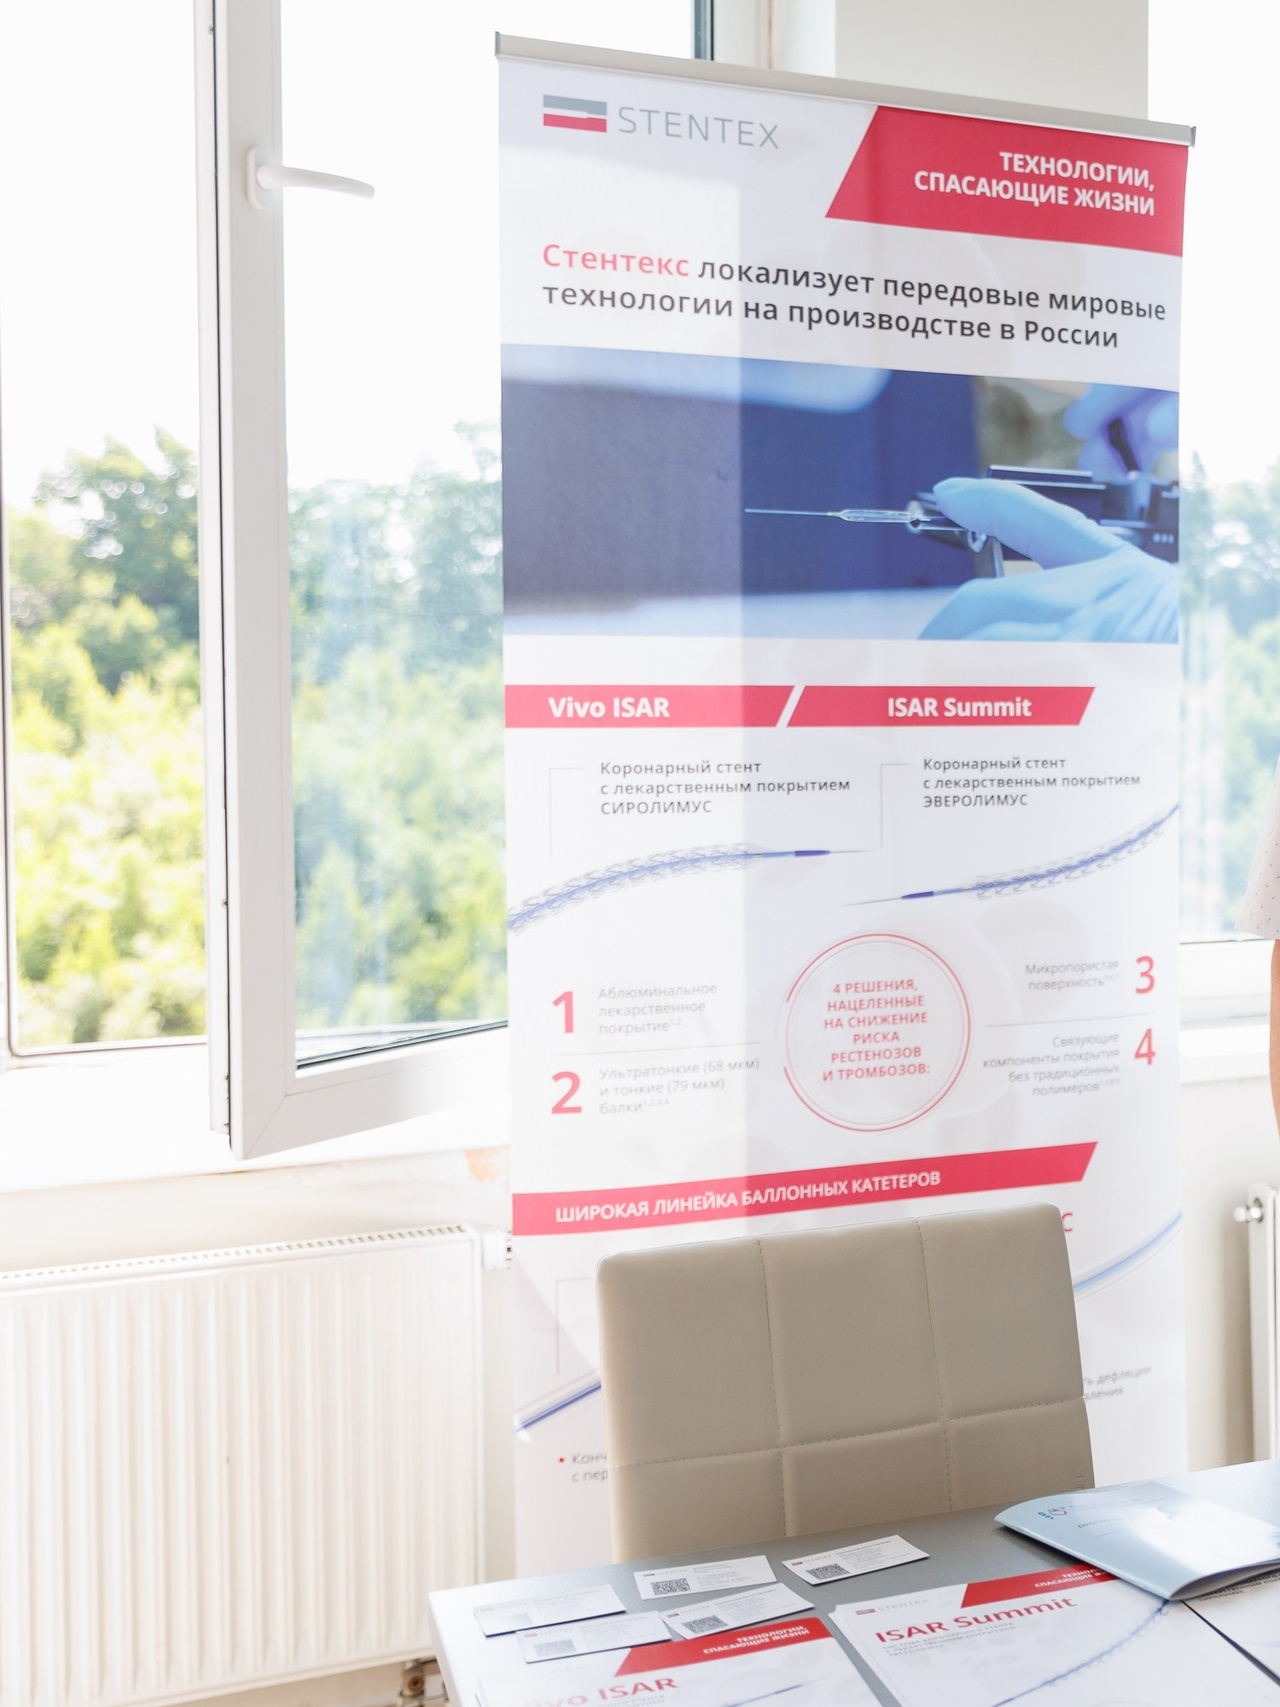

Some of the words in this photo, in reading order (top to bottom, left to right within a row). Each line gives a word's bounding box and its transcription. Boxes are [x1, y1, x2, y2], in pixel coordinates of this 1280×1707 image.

[617, 106, 779, 150] STENTEX
[999, 151, 1155, 191] ТЕХНОЛОГИИ,
[914, 169, 1069, 208] СПАСАЮЩИЕ
[1074, 189, 1155, 217] ЖИЗНИ
[542, 243, 689, 279] Стентекс
[698, 256, 874, 296] локализует
[883, 276, 1040, 311] передовые
[1049, 288, 1167, 323] мировые
[542, 281, 734, 319] технологии
[743, 300, 778, 322] на
[788, 304, 990, 341] производстве
[1000, 320, 1015, 340] в
[1025, 321, 1118, 351] России
[549, 696, 606, 718] Vivo
[613, 696, 670, 719] ISAR
[888, 696, 939, 718] ISAR
[944, 696, 1032, 719] Summit
[600, 760, 711, 782] Коронарный
[717, 761, 761, 775] стент
[923, 755, 1021, 775] Коронарный
[1027, 757, 1065, 770] стент
[601, 782, 610, 795] с
[616, 779, 751, 800] лекарственным
[757, 778, 850, 797] покрытием
[924, 777, 932, 789] с
[938, 774, 1057, 792] лекарственным
[1062, 773, 1140, 790] покрытием
[601, 798, 712, 816] СИРОЛИМУС
[924, 793, 1028, 808] ЭВЕРОЛИМУС
[1026, 959, 1118, 977] Микропористая
[1136, 956, 1155, 994] 3
[598, 983, 717, 999] Аблюминальное
[834, 984, 840, 994] 4
[845, 979, 918, 994] РЕШЕНИЯ,
[552, 991, 574, 1033] 1
[599, 1002, 706, 1018] лекарственное
[828, 996, 924, 1012] НАЦЕЛЕННЫЕ
[824, 1018, 843, 1030] НА
[848, 1012, 928, 1028] СНИЖЕНИЕ
[853, 1031, 900, 1044] РИСКА
[1052, 1032, 1119, 1048] Связующие
[1134, 1028, 1156, 1065] 4
[831, 1047, 921, 1063] РЕСТЕНОЗОВ
[983, 1053, 1060, 1068] компоненты
[1064, 1048, 1119, 1063] покрытия
[600, 1062, 699, 1081] Ультратонкие
[703, 1059, 723, 1074] (68
[728, 1057, 760, 1072] мкм)
[823, 1071, 833, 1082] И
[838, 1064, 930, 1080] ТРОМБОЗОВ:
[1009, 1071, 1029, 1082] без
[1034, 1065, 1119, 1082] традиционных
[551, 1071, 582, 1114] 2
[614, 1084, 663, 1096] тонкие
[667, 1080, 688, 1094] (79
[693, 1078, 725, 1091] мкм)
[555, 1201, 649, 1224] ШИРОКАЯ
[653, 1188, 737, 1217] ЛИНЕЙКА
[742, 1179, 848, 1209] БАЛЛОННЫХ
[852, 1169, 941, 1196] КАТЕТЕРОВ
[875, 1621, 950, 1643] ISAR
[953, 1597, 1078, 1628] Summit
[703, 1635, 771, 1655] СПАСАЮЩИЕ
[599, 1677, 678, 1700] ISAR
